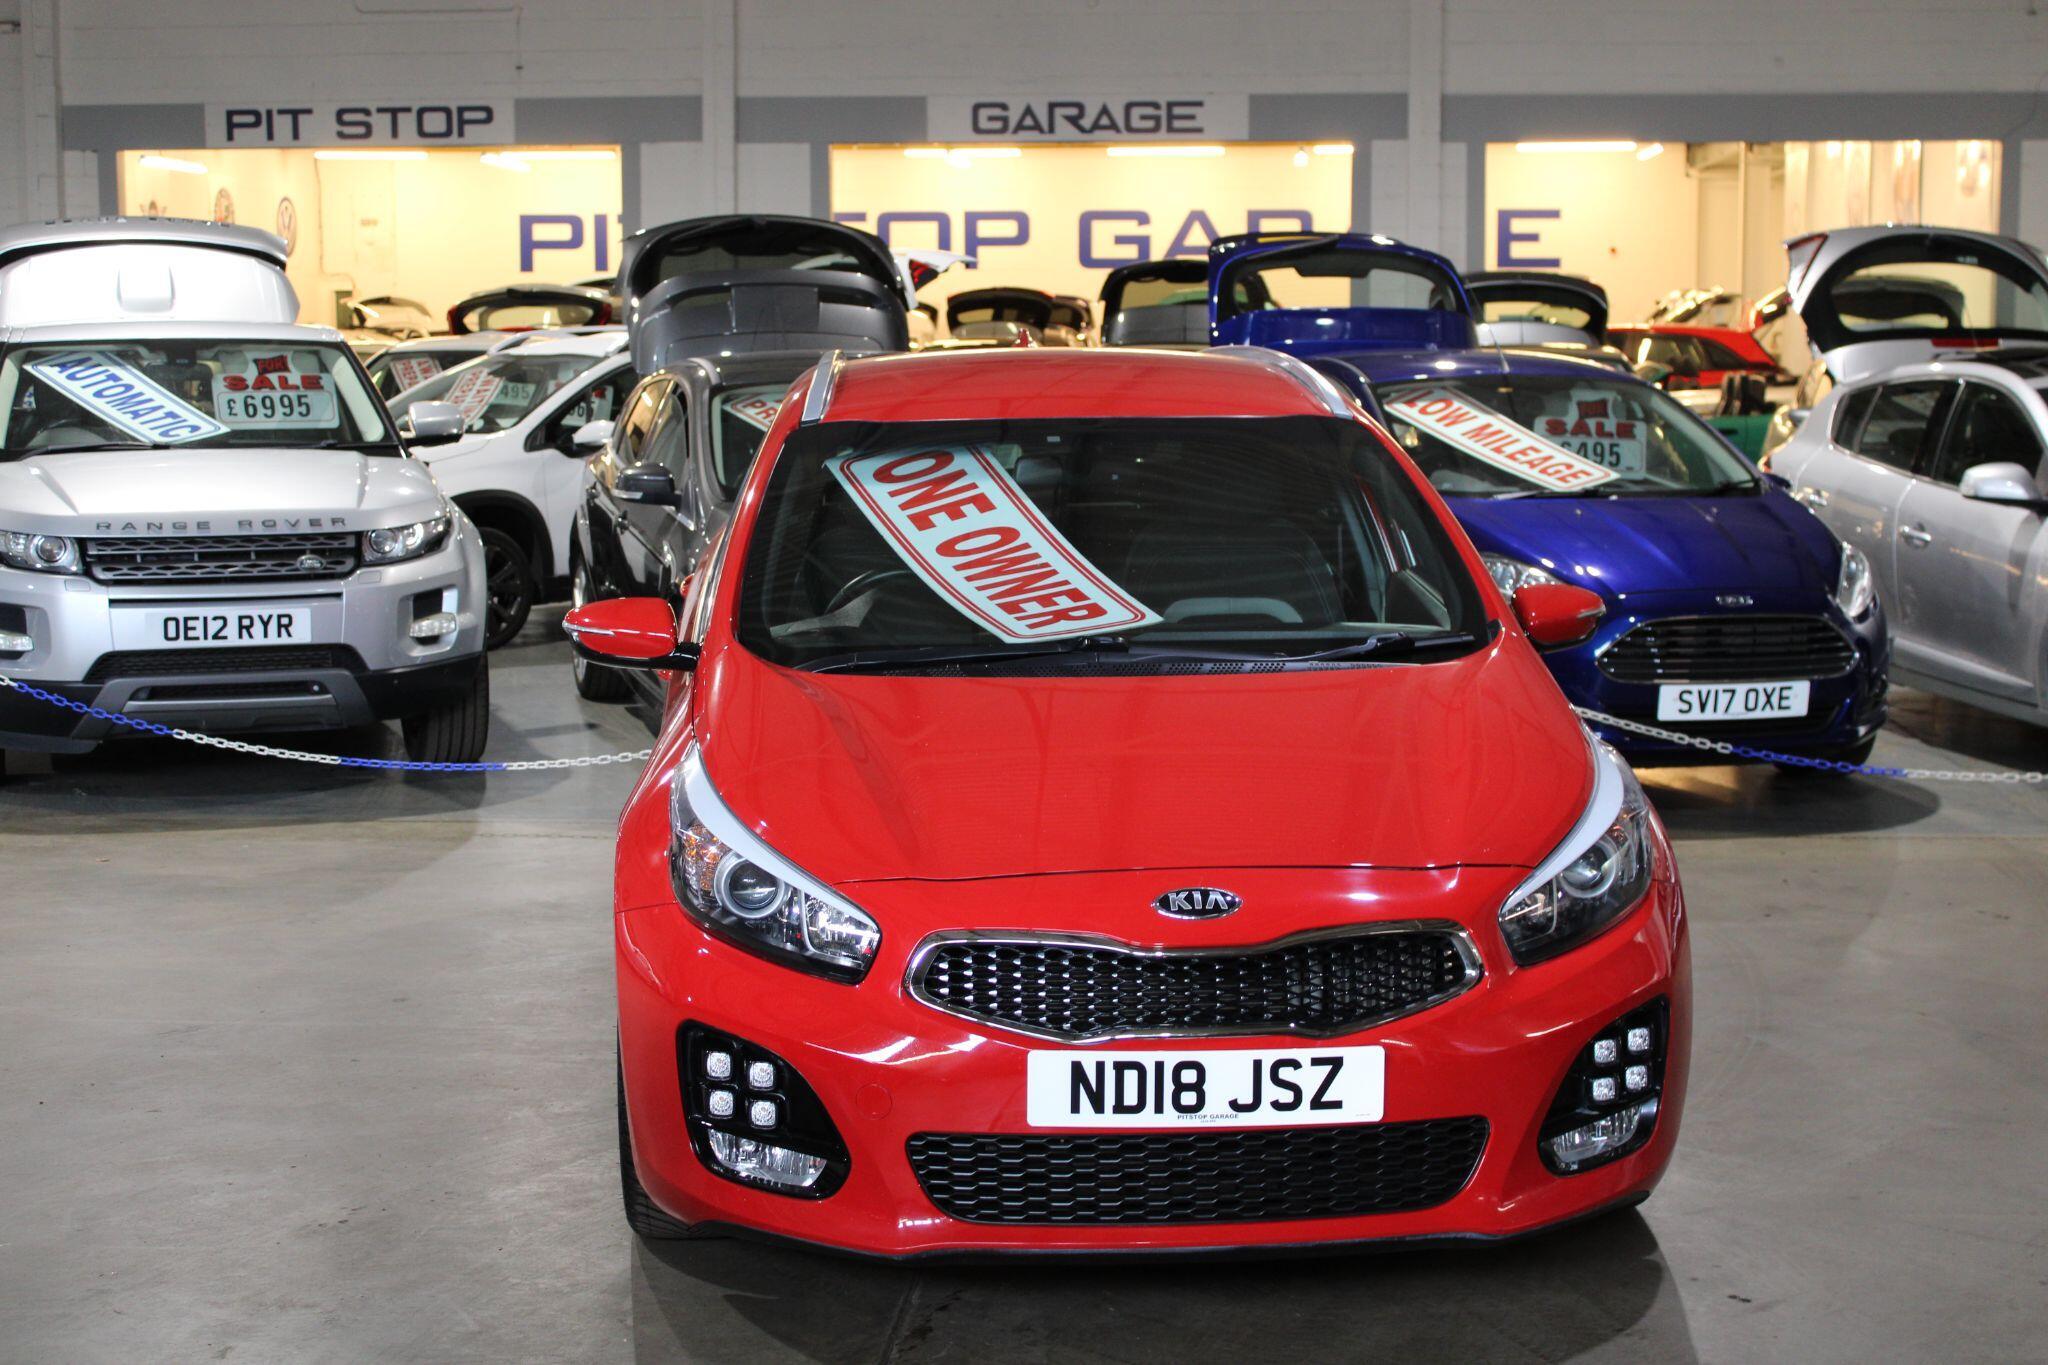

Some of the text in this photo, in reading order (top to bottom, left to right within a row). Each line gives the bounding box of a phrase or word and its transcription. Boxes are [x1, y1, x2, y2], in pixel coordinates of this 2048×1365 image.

[225, 105, 494, 142] PIT STOP
[972, 101, 1204, 135] GARAGE
[519, 213, 622, 272] PI
[51, 356, 202, 439] AUTOMATIC
[222, 373, 325, 391] SALE
[1402, 389, 1593, 484] LOW MILEAGE
[1544, 418, 1637, 439] SALE
[96, 516, 347, 532] RANGE ROVER
[872, 449, 1108, 630] ONE OWNER
[163, 612, 293, 642] OE12 RYR
[1678, 685, 1794, 714] SV17 OXE
[1168, 890, 1229, 911] KIA
[1070, 1056, 1344, 1115] ND18 JSZ
